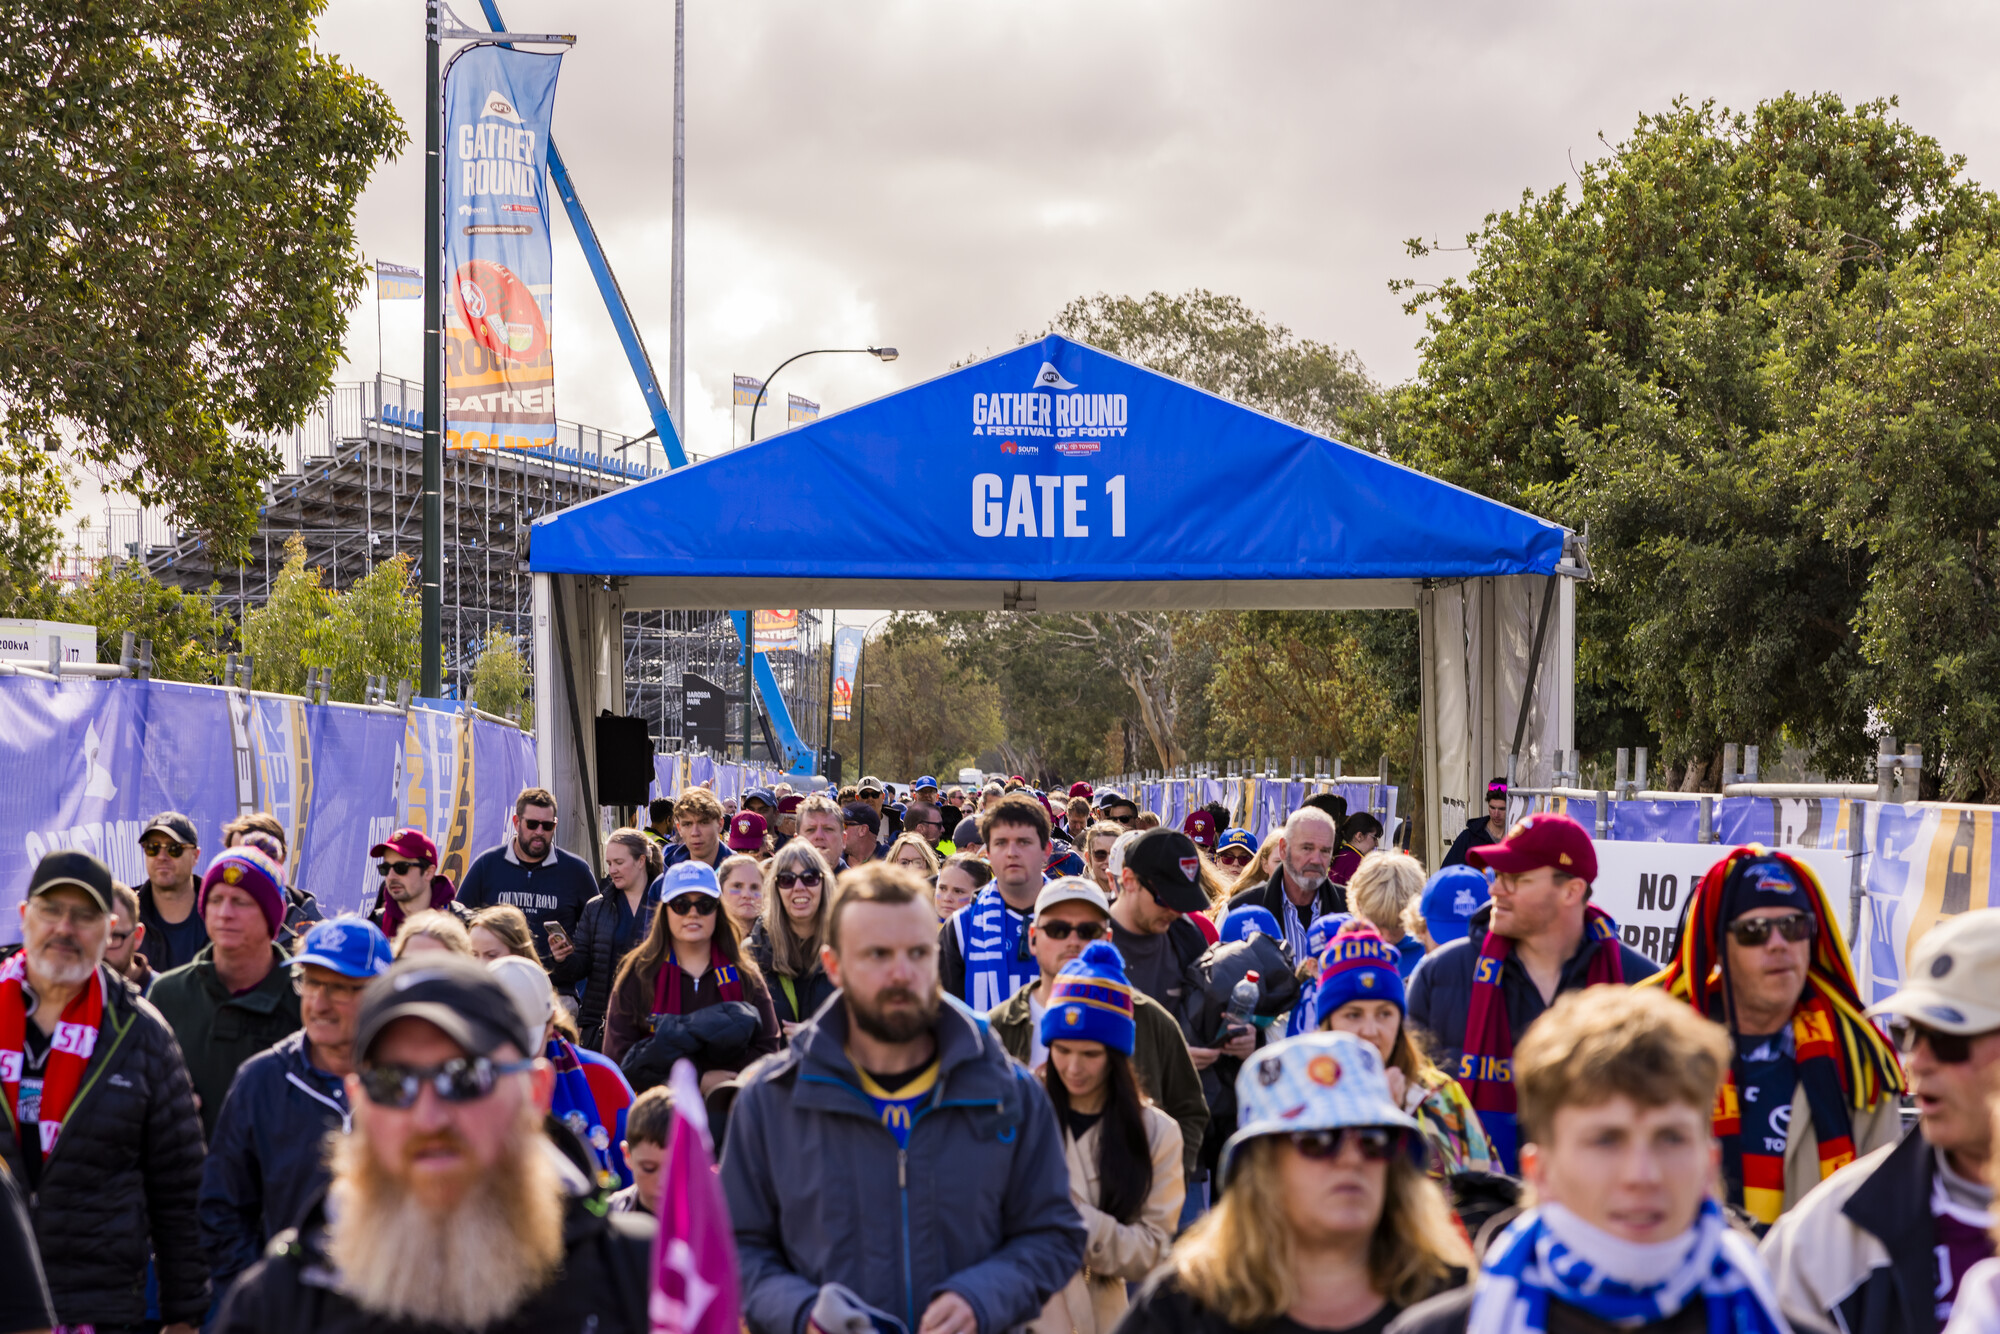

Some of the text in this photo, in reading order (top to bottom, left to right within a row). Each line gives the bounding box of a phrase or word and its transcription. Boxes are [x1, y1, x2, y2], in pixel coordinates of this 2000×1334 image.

[459, 123, 535, 165] GATHER
[463, 160, 535, 197] ROUND
[973, 393, 1127, 427] GATHER ROUND
[973, 426, 1127, 437] A FESTIVAL OF FOOTY
[972, 473, 1125, 537] GATE 1
[686, 691, 711, 699] BAROSSA
[498, 891, 558, 910] COUNTRY ROAD
[1637, 873, 1678, 911] NO
